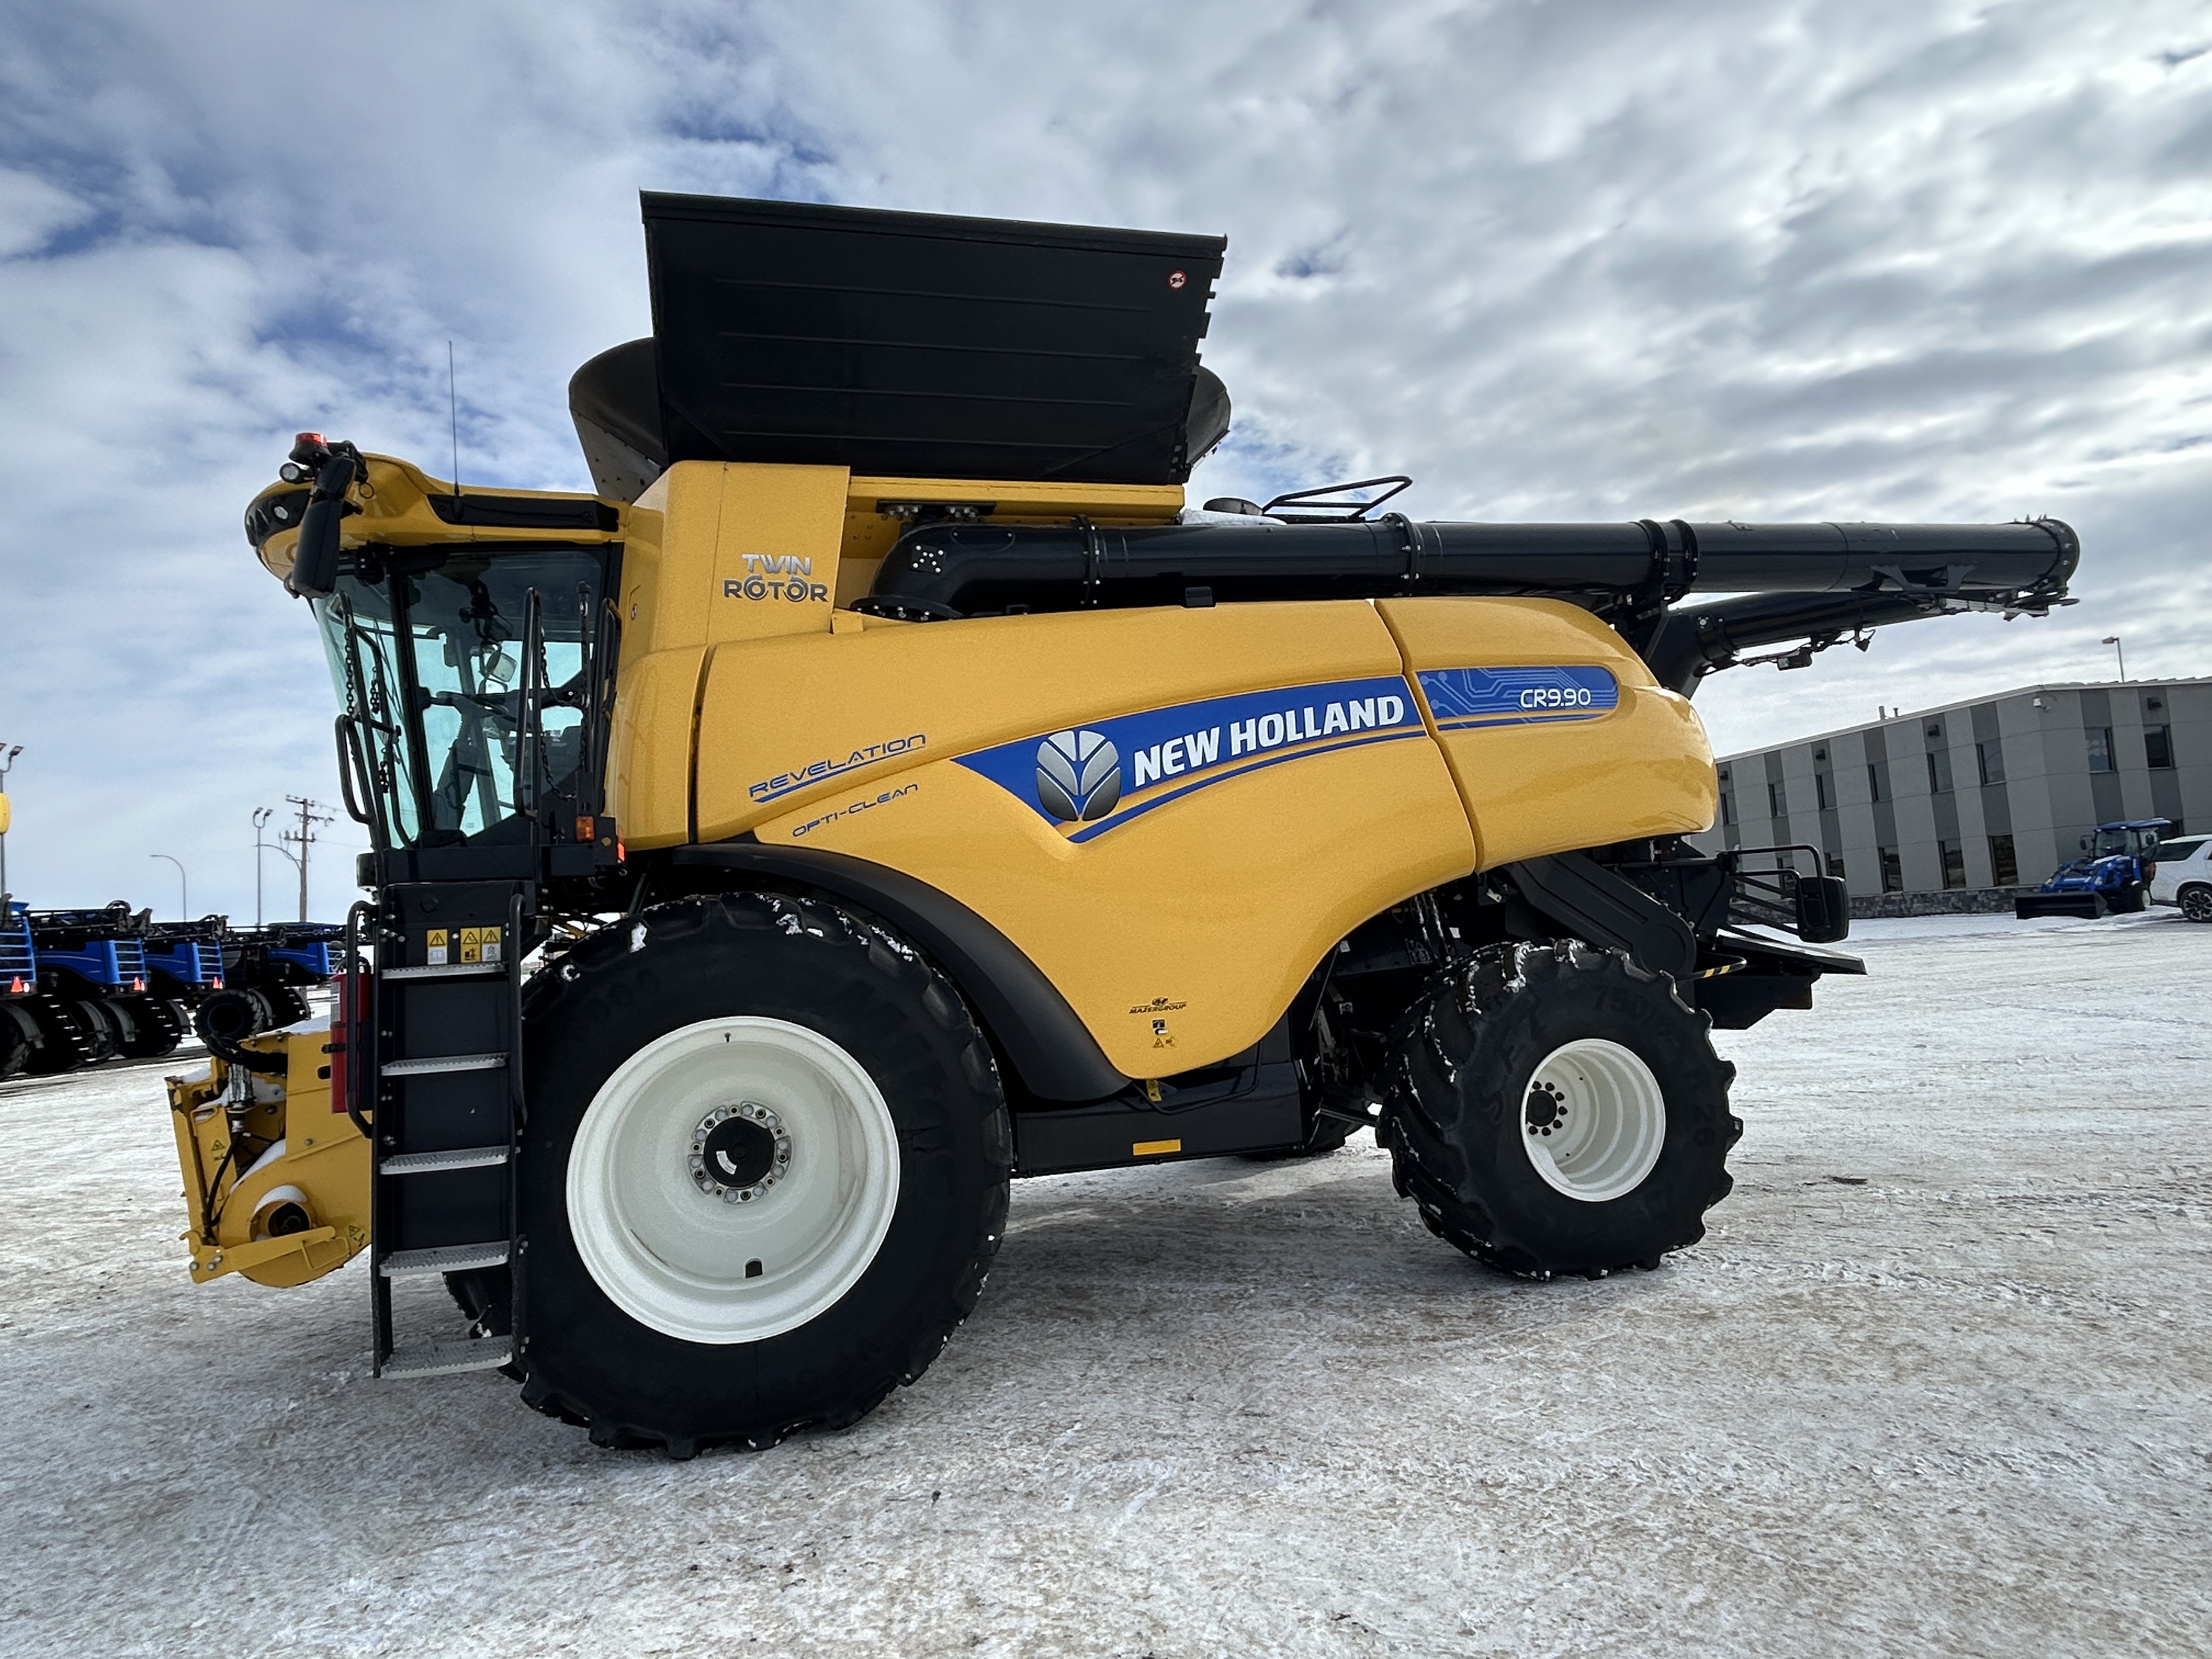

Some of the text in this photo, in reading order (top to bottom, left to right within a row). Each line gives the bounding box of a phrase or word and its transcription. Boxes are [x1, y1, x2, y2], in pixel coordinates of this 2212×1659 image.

[742, 553, 812, 575] TWIN
[723, 573, 829, 602] ROTOR
[1520, 688, 1592, 708] CR9.90
[1133, 695, 1404, 787] NEW HOLLAND
[748, 733, 927, 798] REVELATION
[792, 783, 918, 838] OPTI-CLEAN
